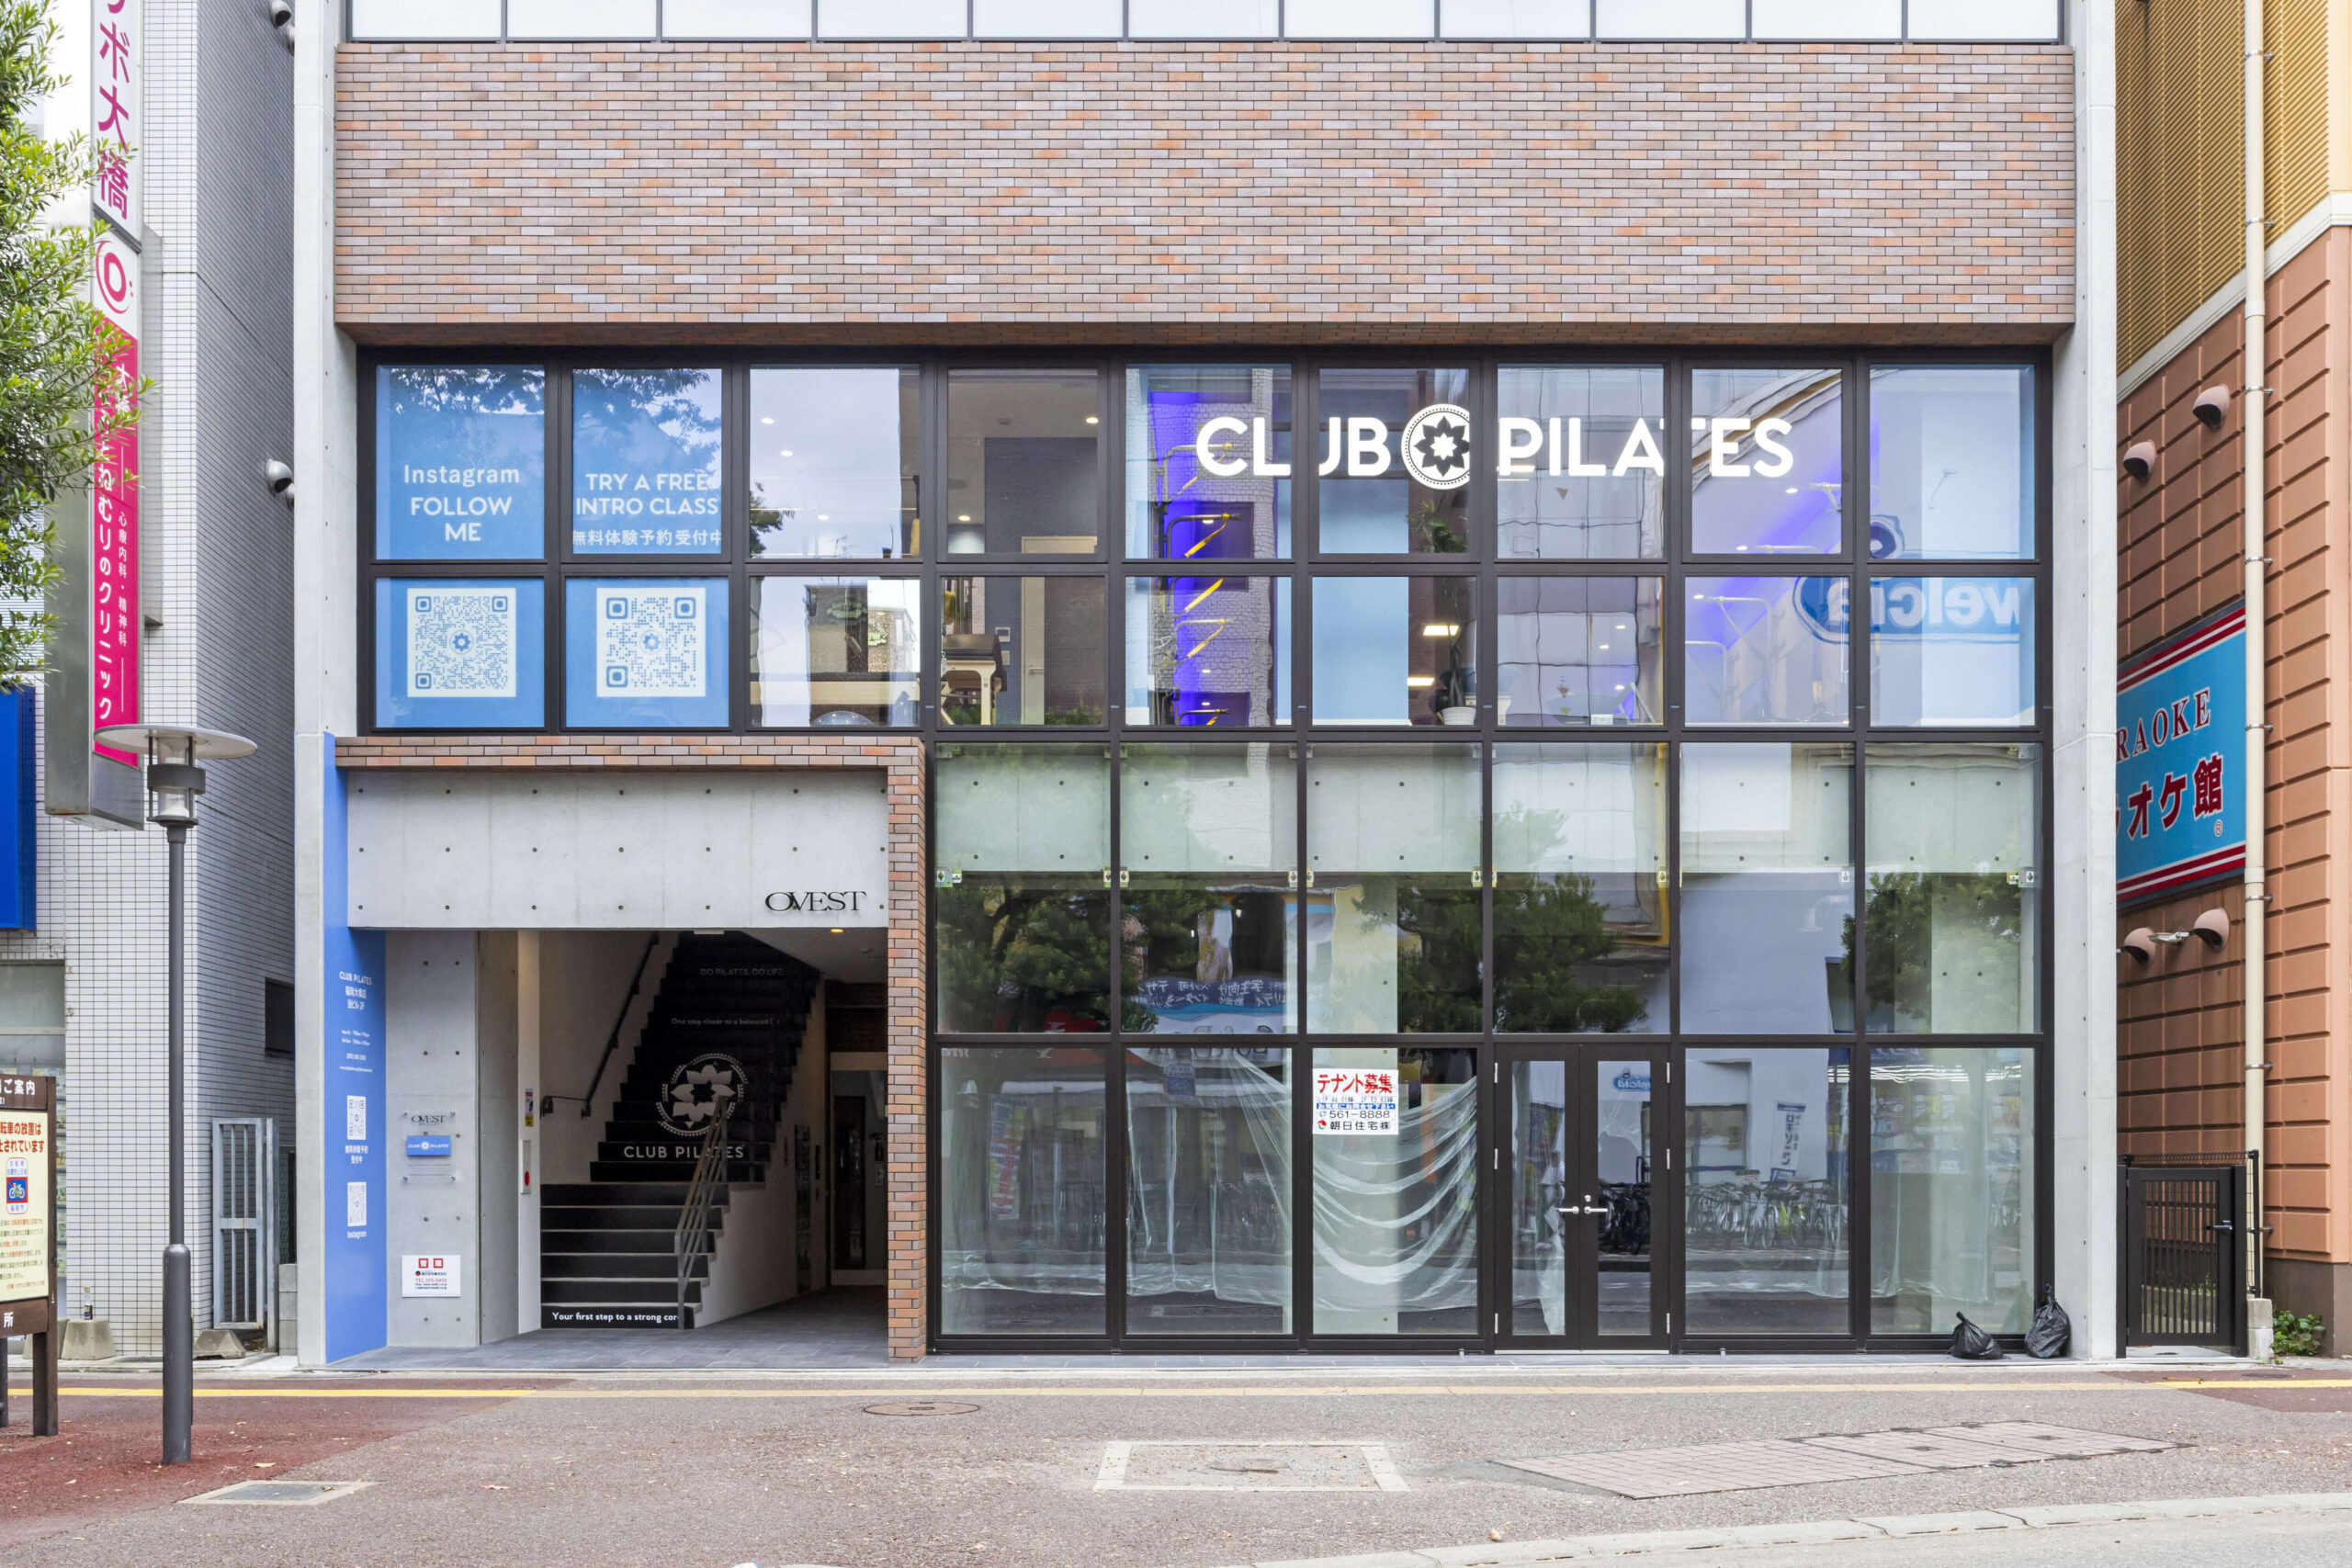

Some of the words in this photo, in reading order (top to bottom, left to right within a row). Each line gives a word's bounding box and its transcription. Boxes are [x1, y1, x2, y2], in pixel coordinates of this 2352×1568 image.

[97, 0, 130, 220] ボ大橋
[404, 464, 519, 488] Instagram
[585, 473, 628, 491] TRY
[634, 473, 650, 491] A
[657, 473, 708, 491] FREE
[411, 497, 513, 516] FOLLOW
[576, 498, 644, 515] INTRO
[650, 498, 718, 515] CLASS
[445, 523, 481, 541] ME
[2116, 751, 2223, 840] オケ館
[765, 891, 866, 911] OVEST
[0, 1078, 36, 1096] ご案内
[1317, 1073, 1393, 1094] テナント募集
[1329, 1110, 1390, 1119] 561-8888
[624, 1145, 667, 1158] CLUB
[4, 1312, 14, 1328] 所
[552, 1312, 573, 1321] Your
[576, 1312, 594, 1321] first
[595, 1314, 614, 1323] step
[634, 1314, 662, 1324] strong
